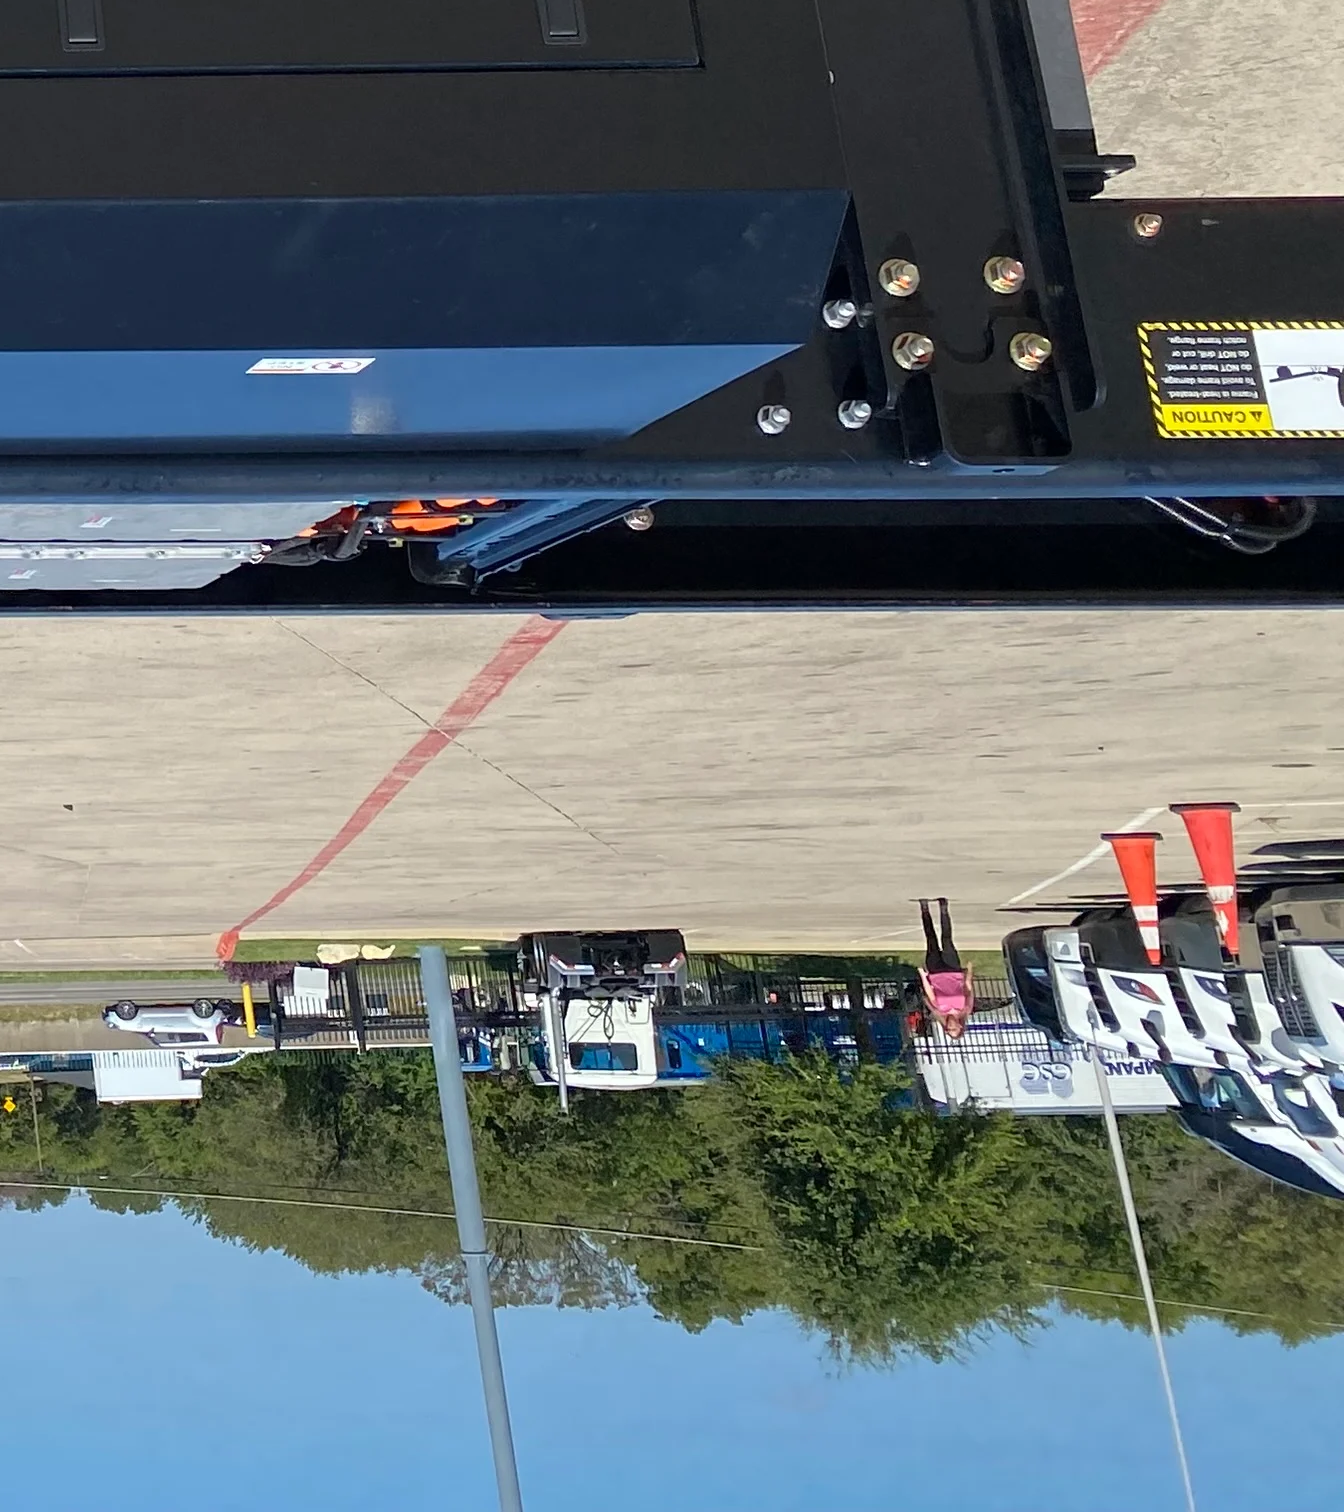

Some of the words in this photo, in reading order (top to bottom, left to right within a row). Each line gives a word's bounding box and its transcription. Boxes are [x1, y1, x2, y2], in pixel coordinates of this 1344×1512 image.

[1218, 350, 1237, 358] NOT
[1220, 364, 1240, 372] NOT
[1172, 410, 1246, 424] CAUTION
[1104, 1062, 1162, 1076] MPAN
